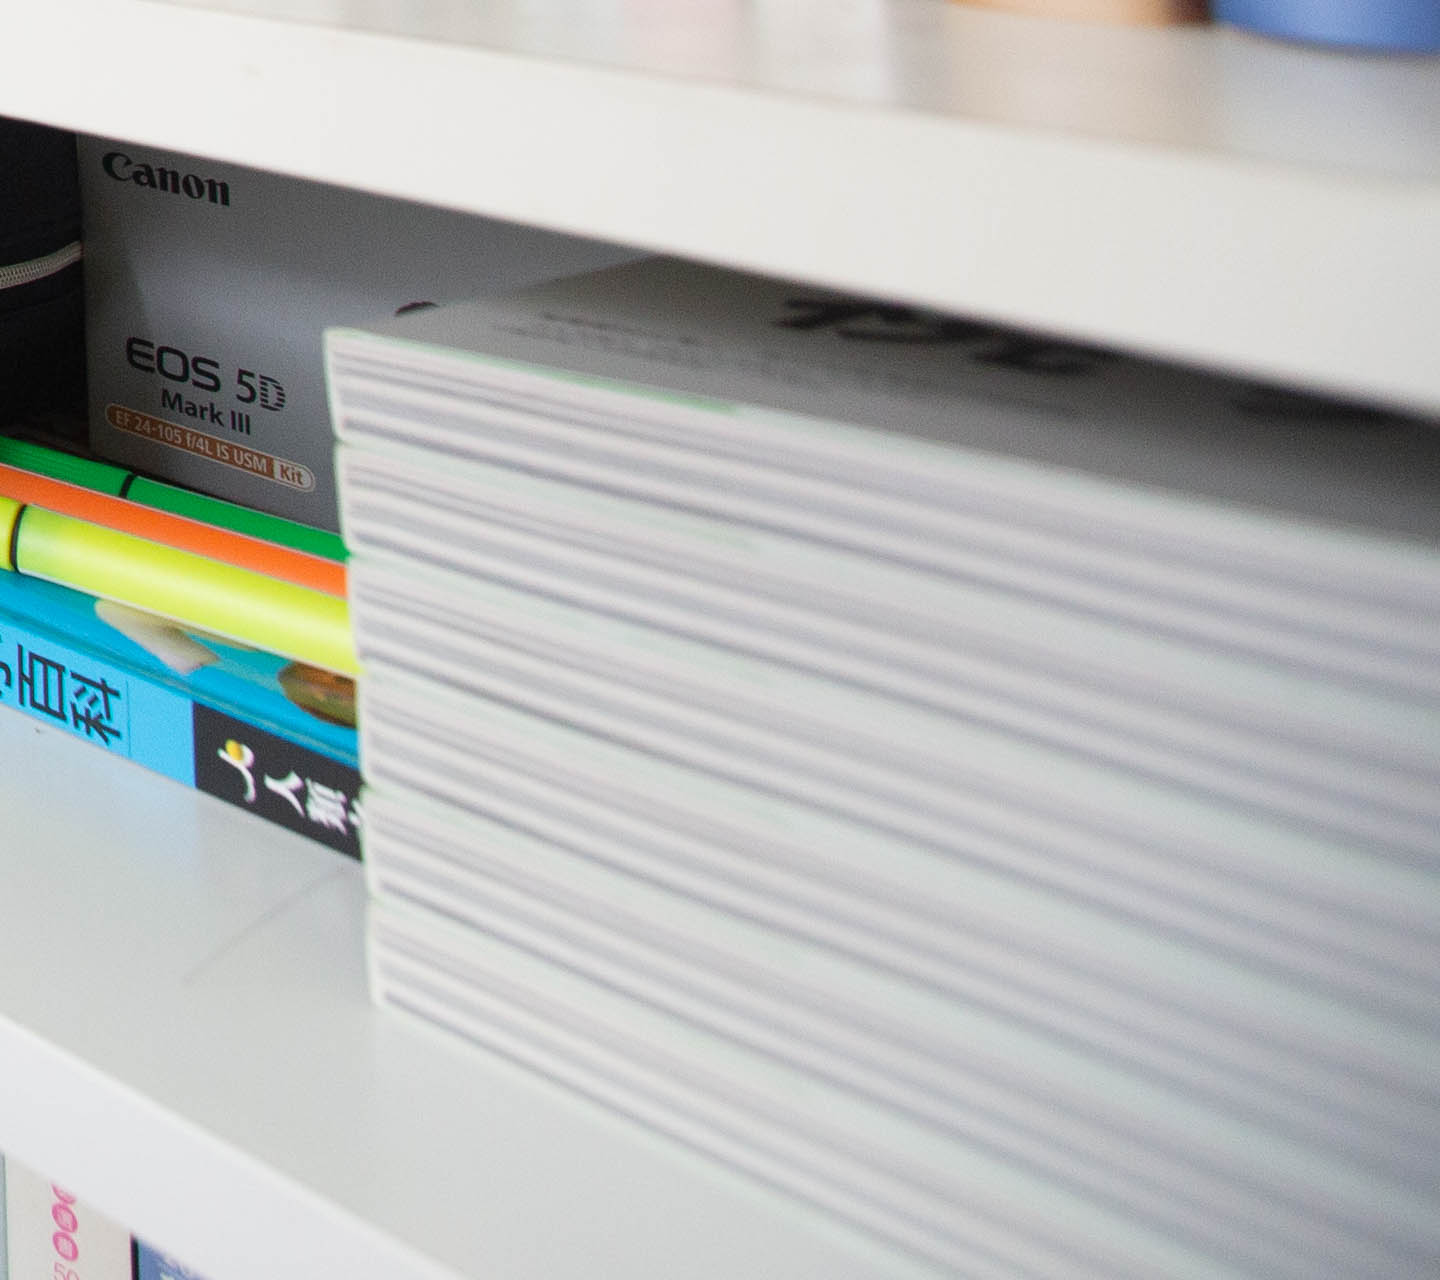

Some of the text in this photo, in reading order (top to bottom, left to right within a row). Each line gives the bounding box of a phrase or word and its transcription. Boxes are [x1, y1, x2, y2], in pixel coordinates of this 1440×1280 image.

[102, 151, 231, 206] Canon
[126, 337, 286, 412] EOS 5D
[160, 388, 252, 436] Mark III
[115, 409, 131, 427] EF
[134, 414, 182, 445] 24-105
[233, 445, 267, 473] USM
[279, 458, 304, 486] Kit
